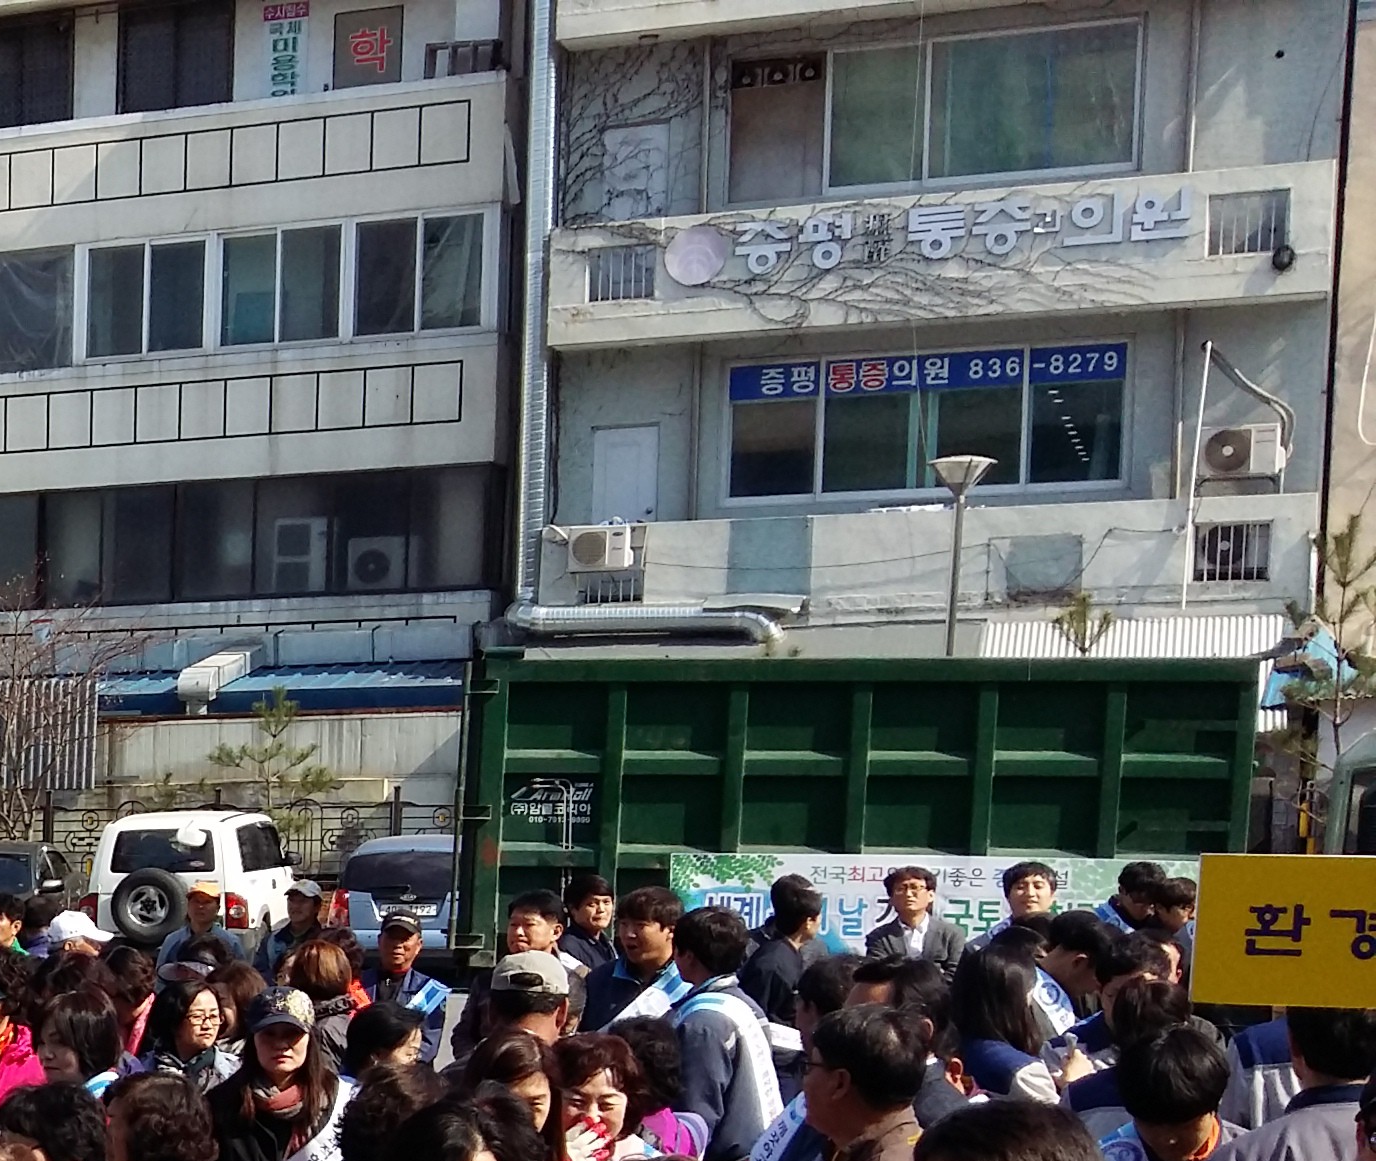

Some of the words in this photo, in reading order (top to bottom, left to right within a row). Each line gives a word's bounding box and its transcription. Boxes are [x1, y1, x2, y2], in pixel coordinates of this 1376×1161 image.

[349, 25, 394, 73] 학
[734, 211, 853, 276] 증평
[759, 366, 816, 396] 증평
[827, 356, 949, 392] 통증의원
[933, 867, 987, 888] 기좋은
